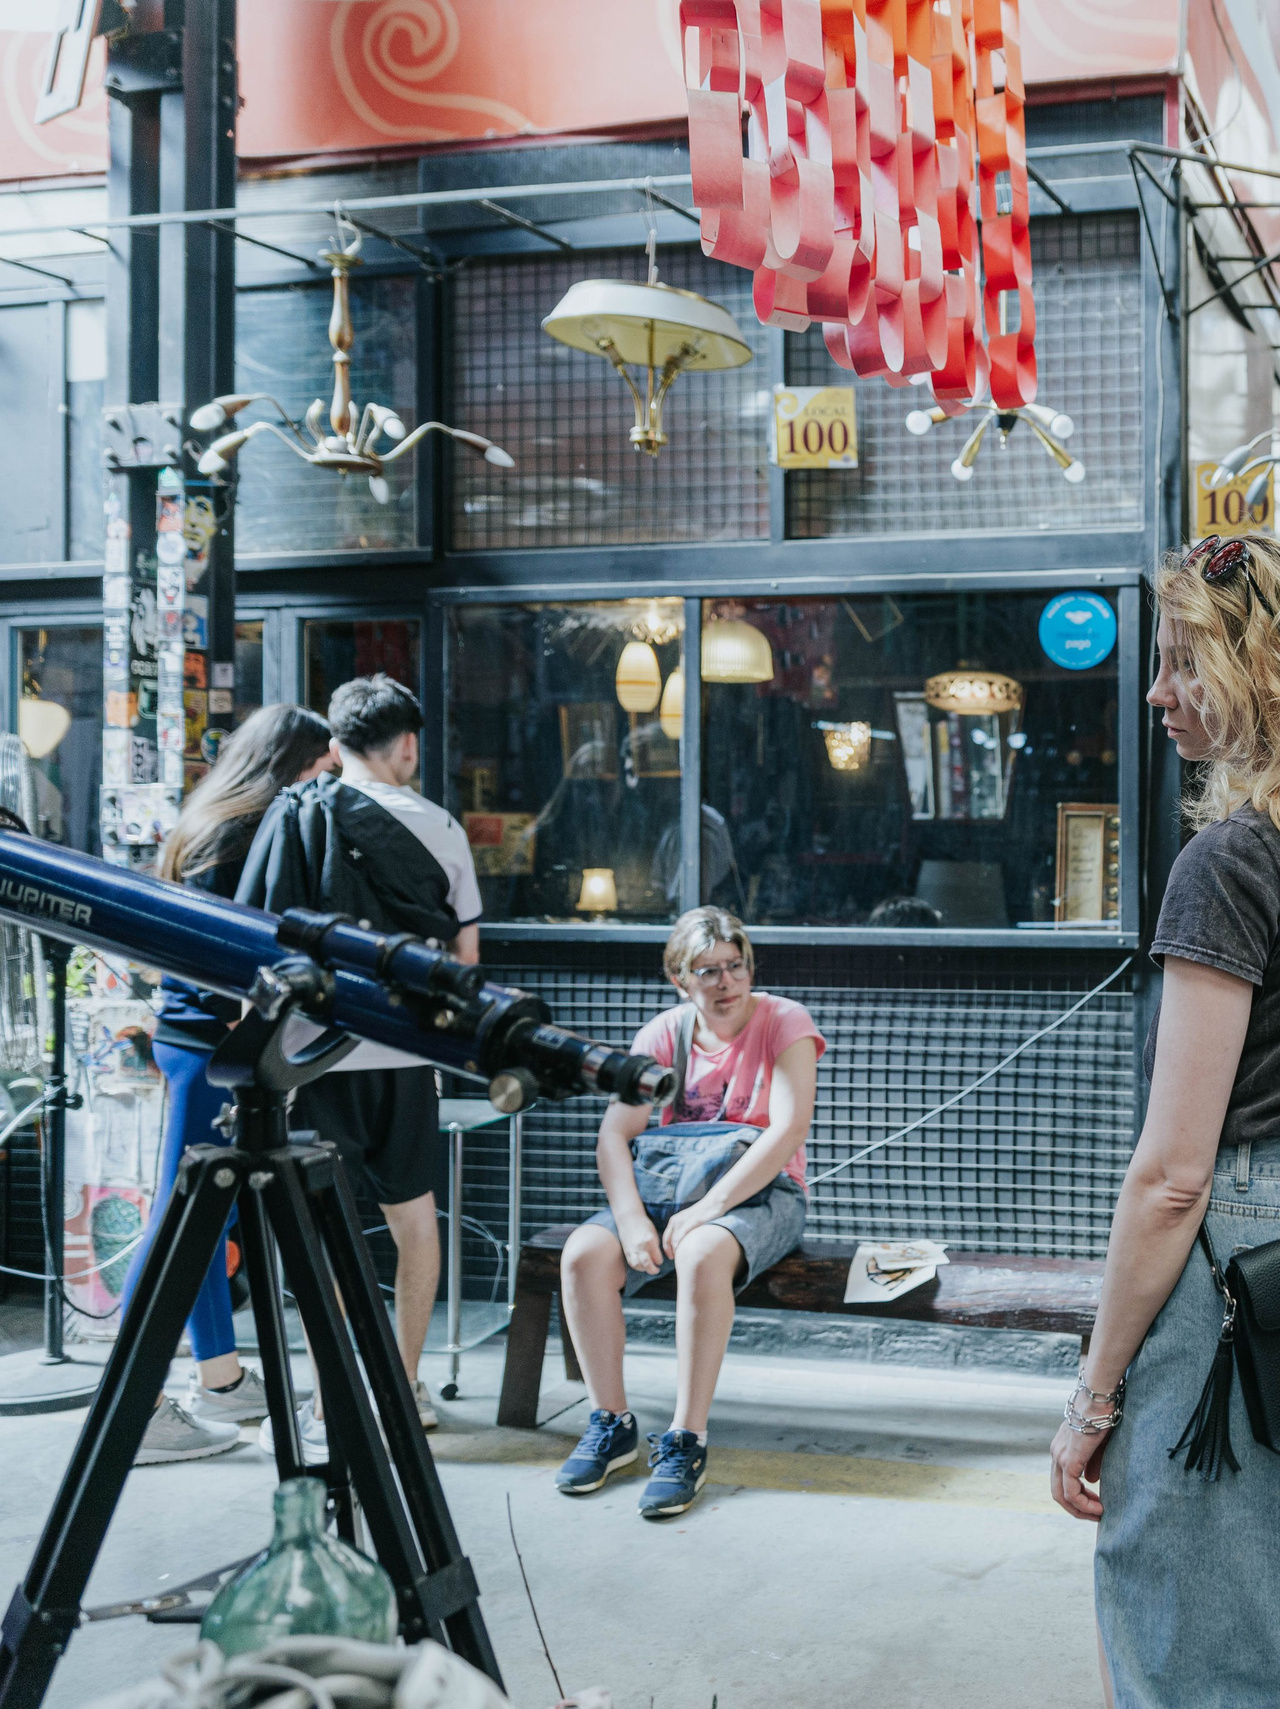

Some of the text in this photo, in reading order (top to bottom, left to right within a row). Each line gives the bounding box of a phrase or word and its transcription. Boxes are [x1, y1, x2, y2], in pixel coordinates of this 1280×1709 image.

[782, 419, 849, 455] 100
[1202, 489, 1269, 526] 100
[0, 879, 93, 926] JUPITER
